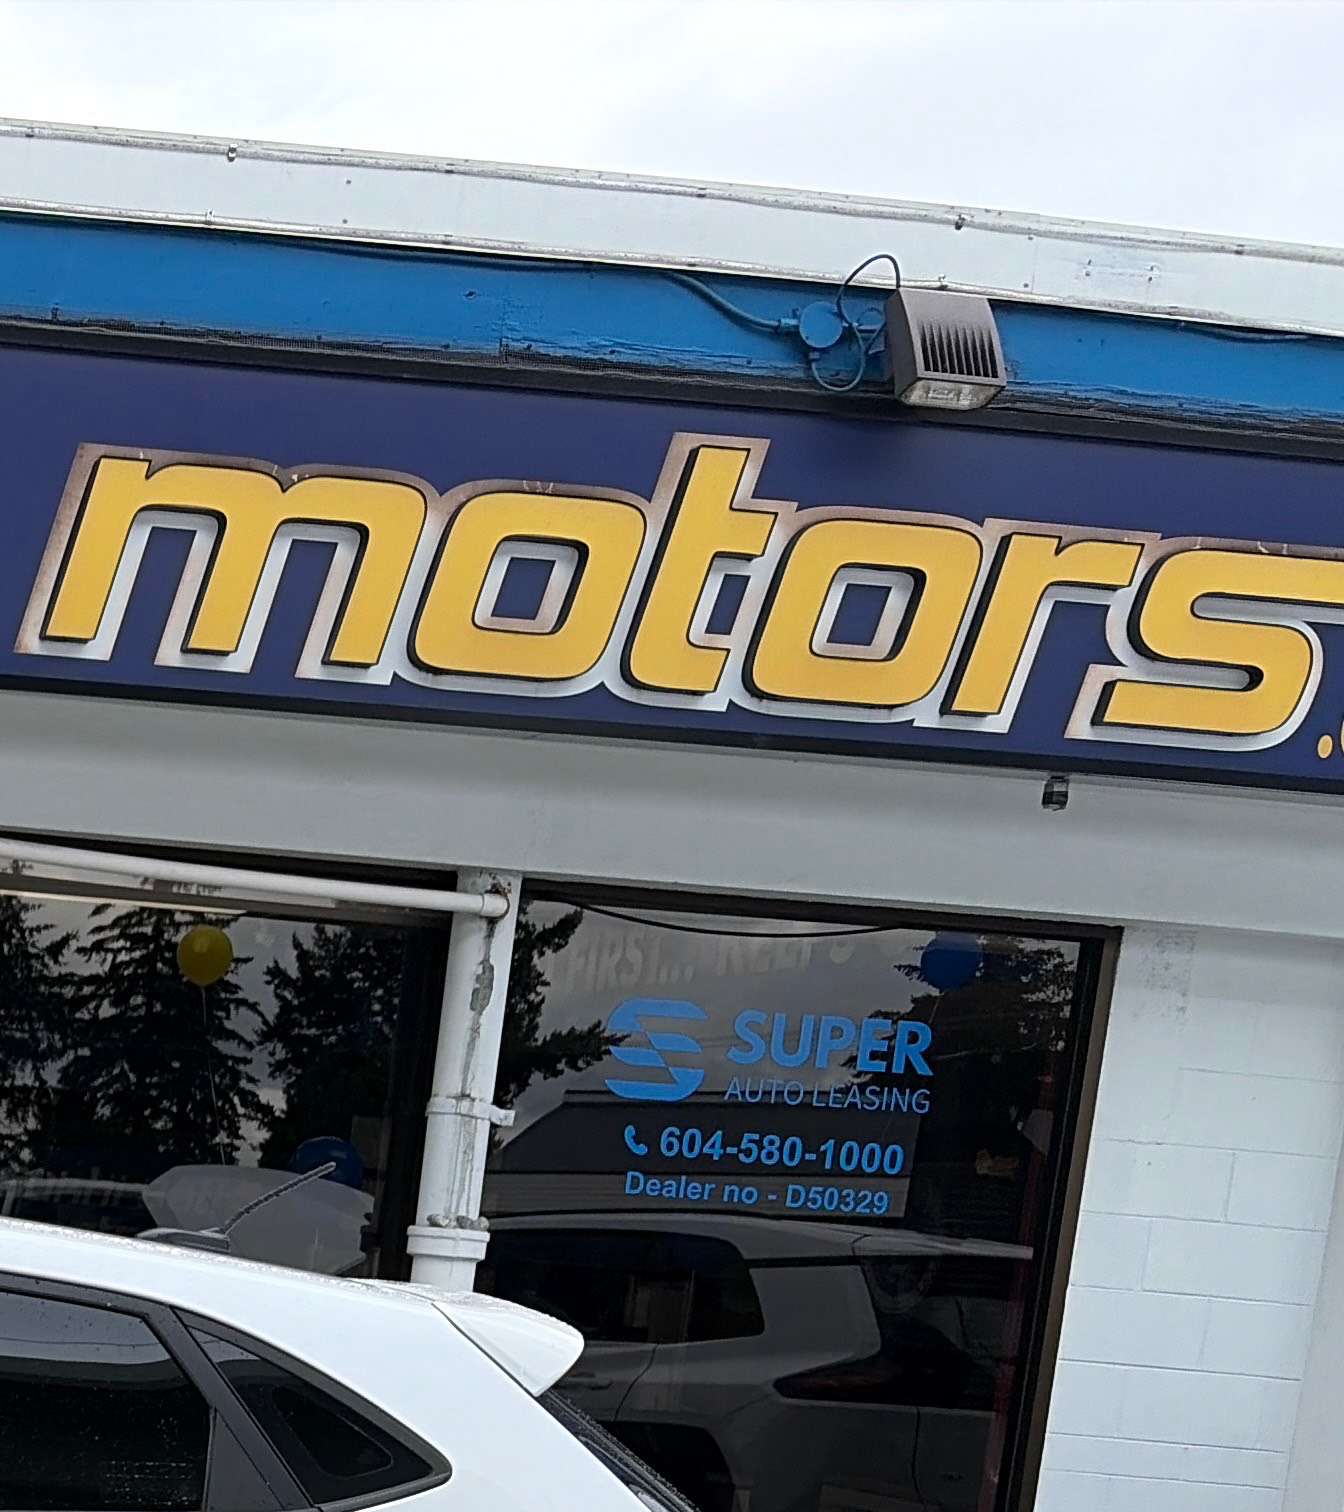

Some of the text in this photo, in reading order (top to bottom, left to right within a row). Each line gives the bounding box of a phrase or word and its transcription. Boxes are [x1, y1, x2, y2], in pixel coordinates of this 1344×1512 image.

[27, 438, 1318, 744] motors
[727, 1010, 933, 1076] SUPER
[724, 1076, 931, 1115] AUTO LEASING
[659, 1125, 905, 1175] 604-580-1000
[625, 1171, 717, 1202] Dealer
[723, 1184, 758, 1205] no
[786, 1184, 890, 1215] D50329
